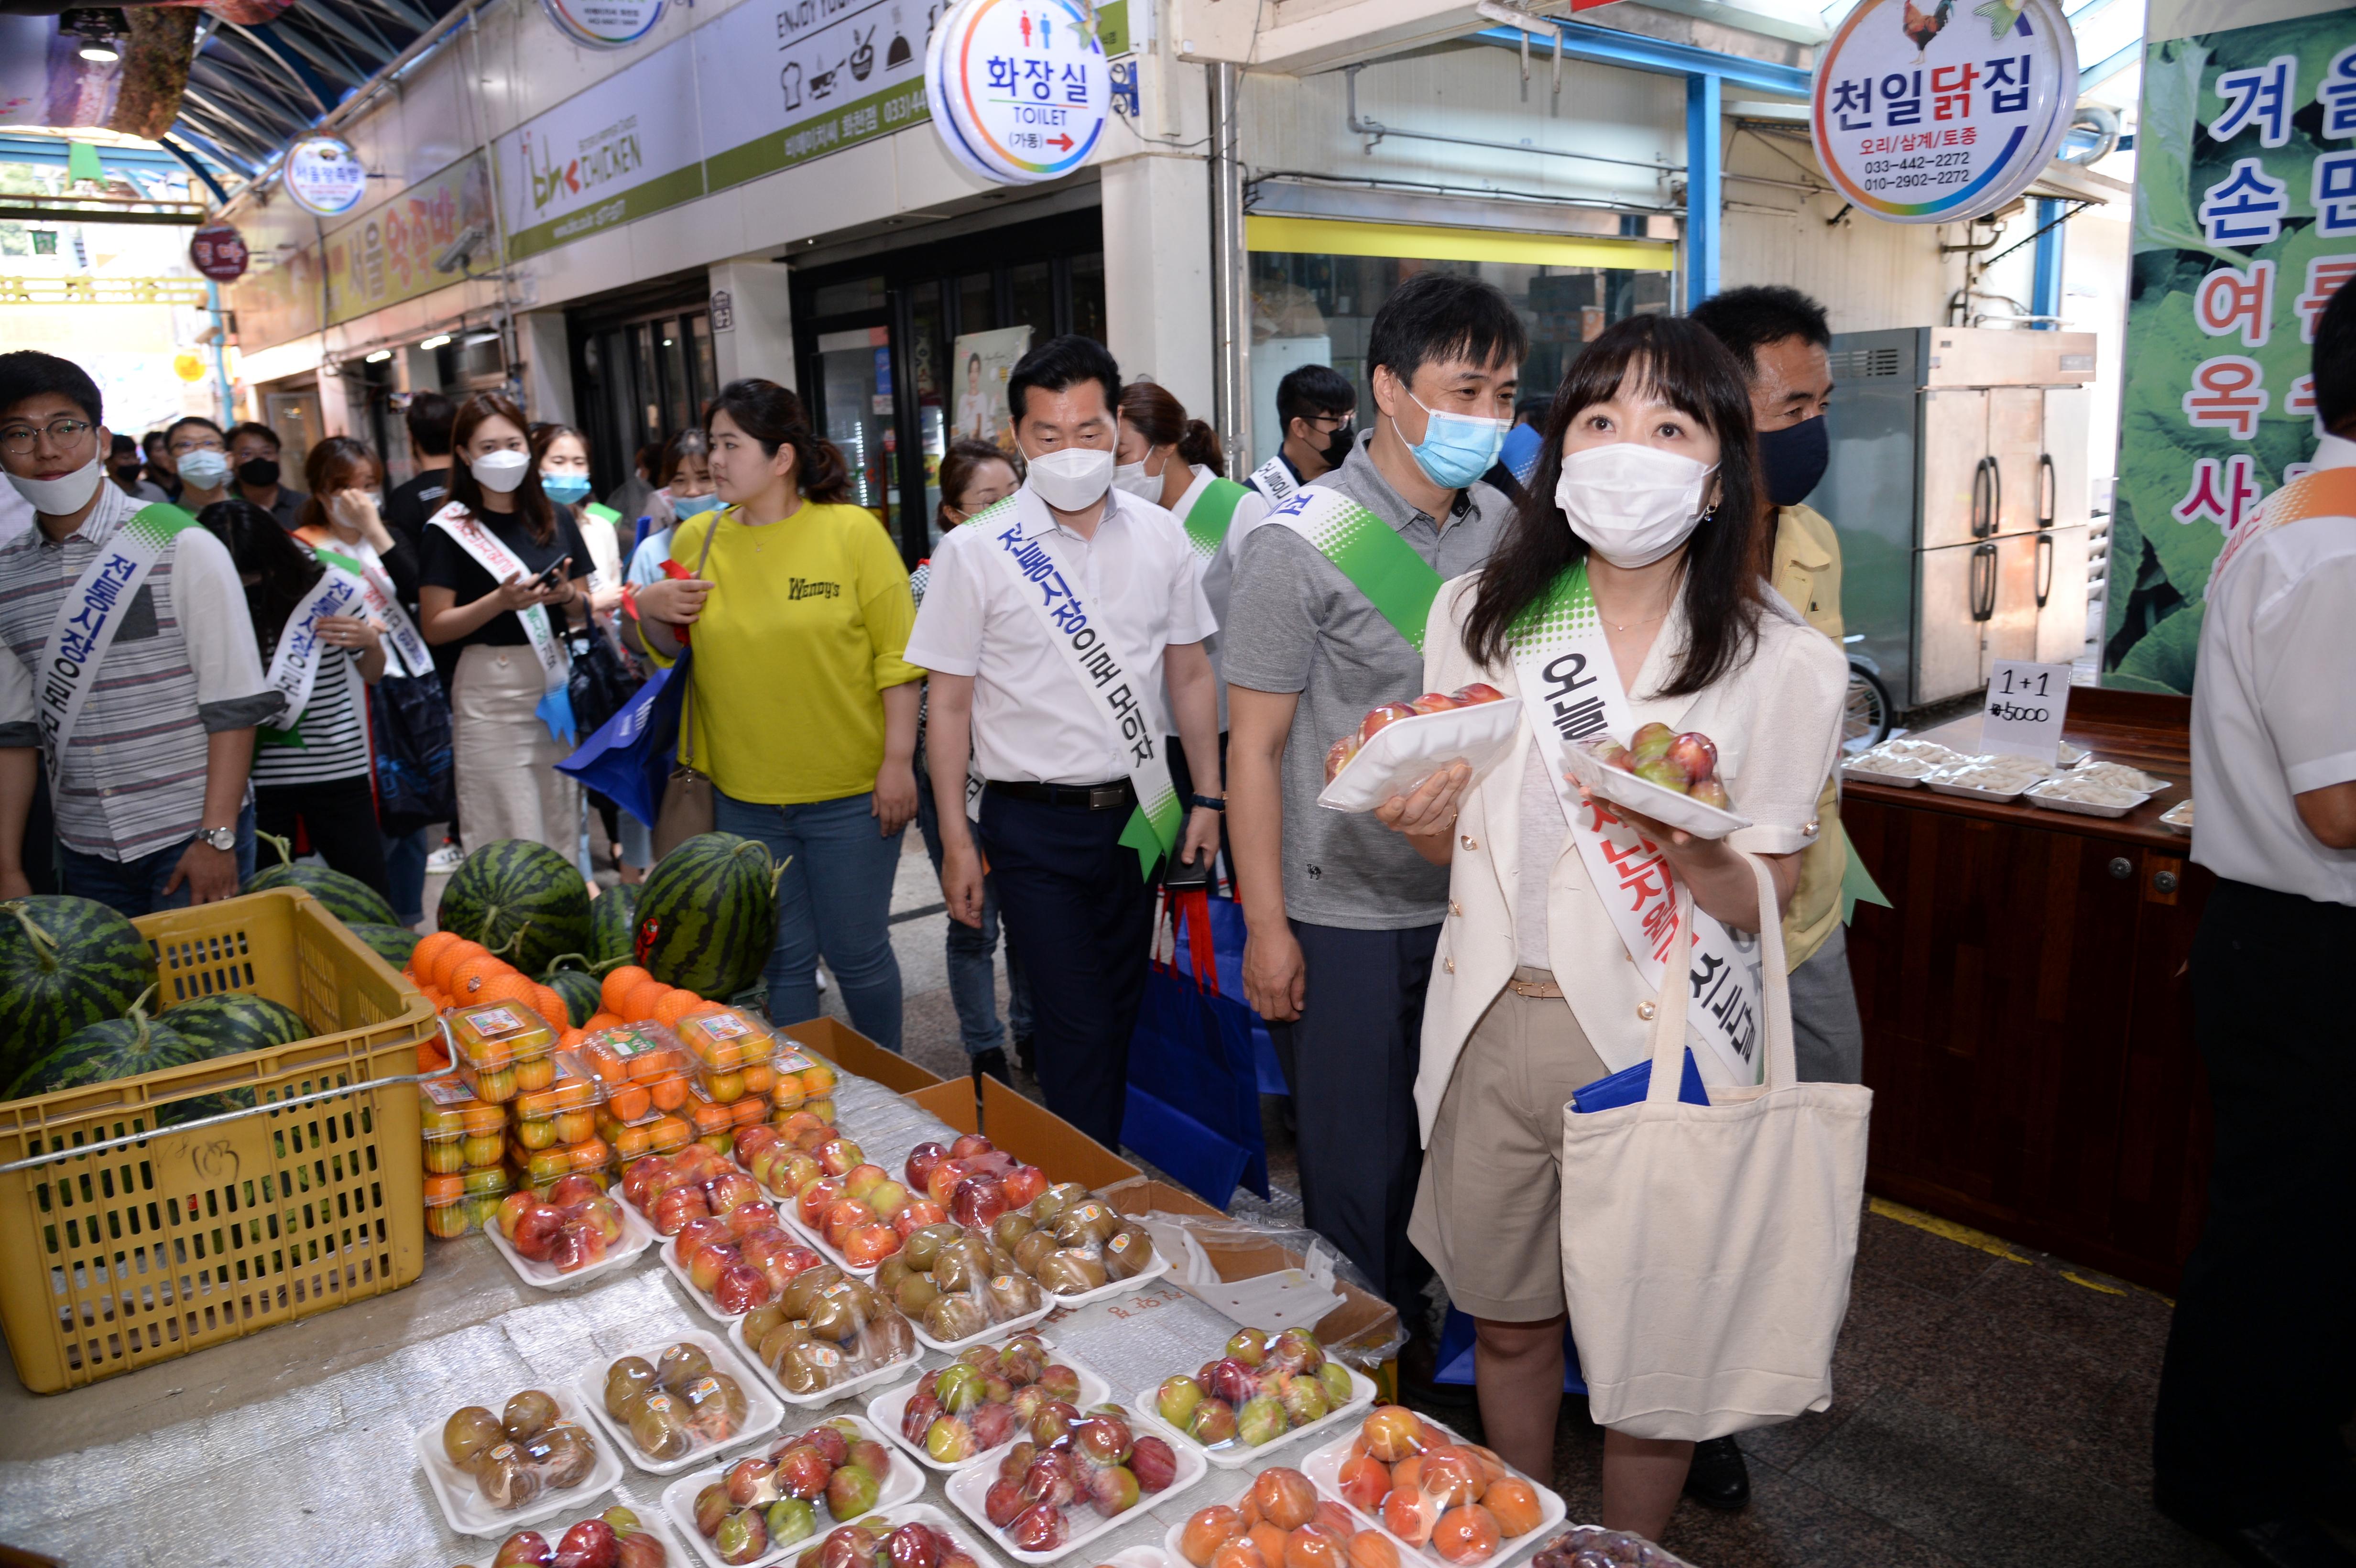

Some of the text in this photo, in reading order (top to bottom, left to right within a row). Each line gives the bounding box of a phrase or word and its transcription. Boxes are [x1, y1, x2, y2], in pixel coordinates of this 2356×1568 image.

[987, 56, 1087, 103] 화장실
[1832, 54, 2031, 131] 천일닭집
[1014, 107, 1067, 125] TOILET
[1009, 132, 1043, 148] (가동)
[1859, 127, 1977, 155] 오리/삼계/토종
[580, 133, 642, 189] CHICKEN
[1865, 152, 1970, 174] 033-442-2272
[1865, 170, 1969, 191] 010-2902-2272
[41, 553, 138, 715] 전통시장으로
[997, 522, 1154, 768] 전통시장으로 모이자
